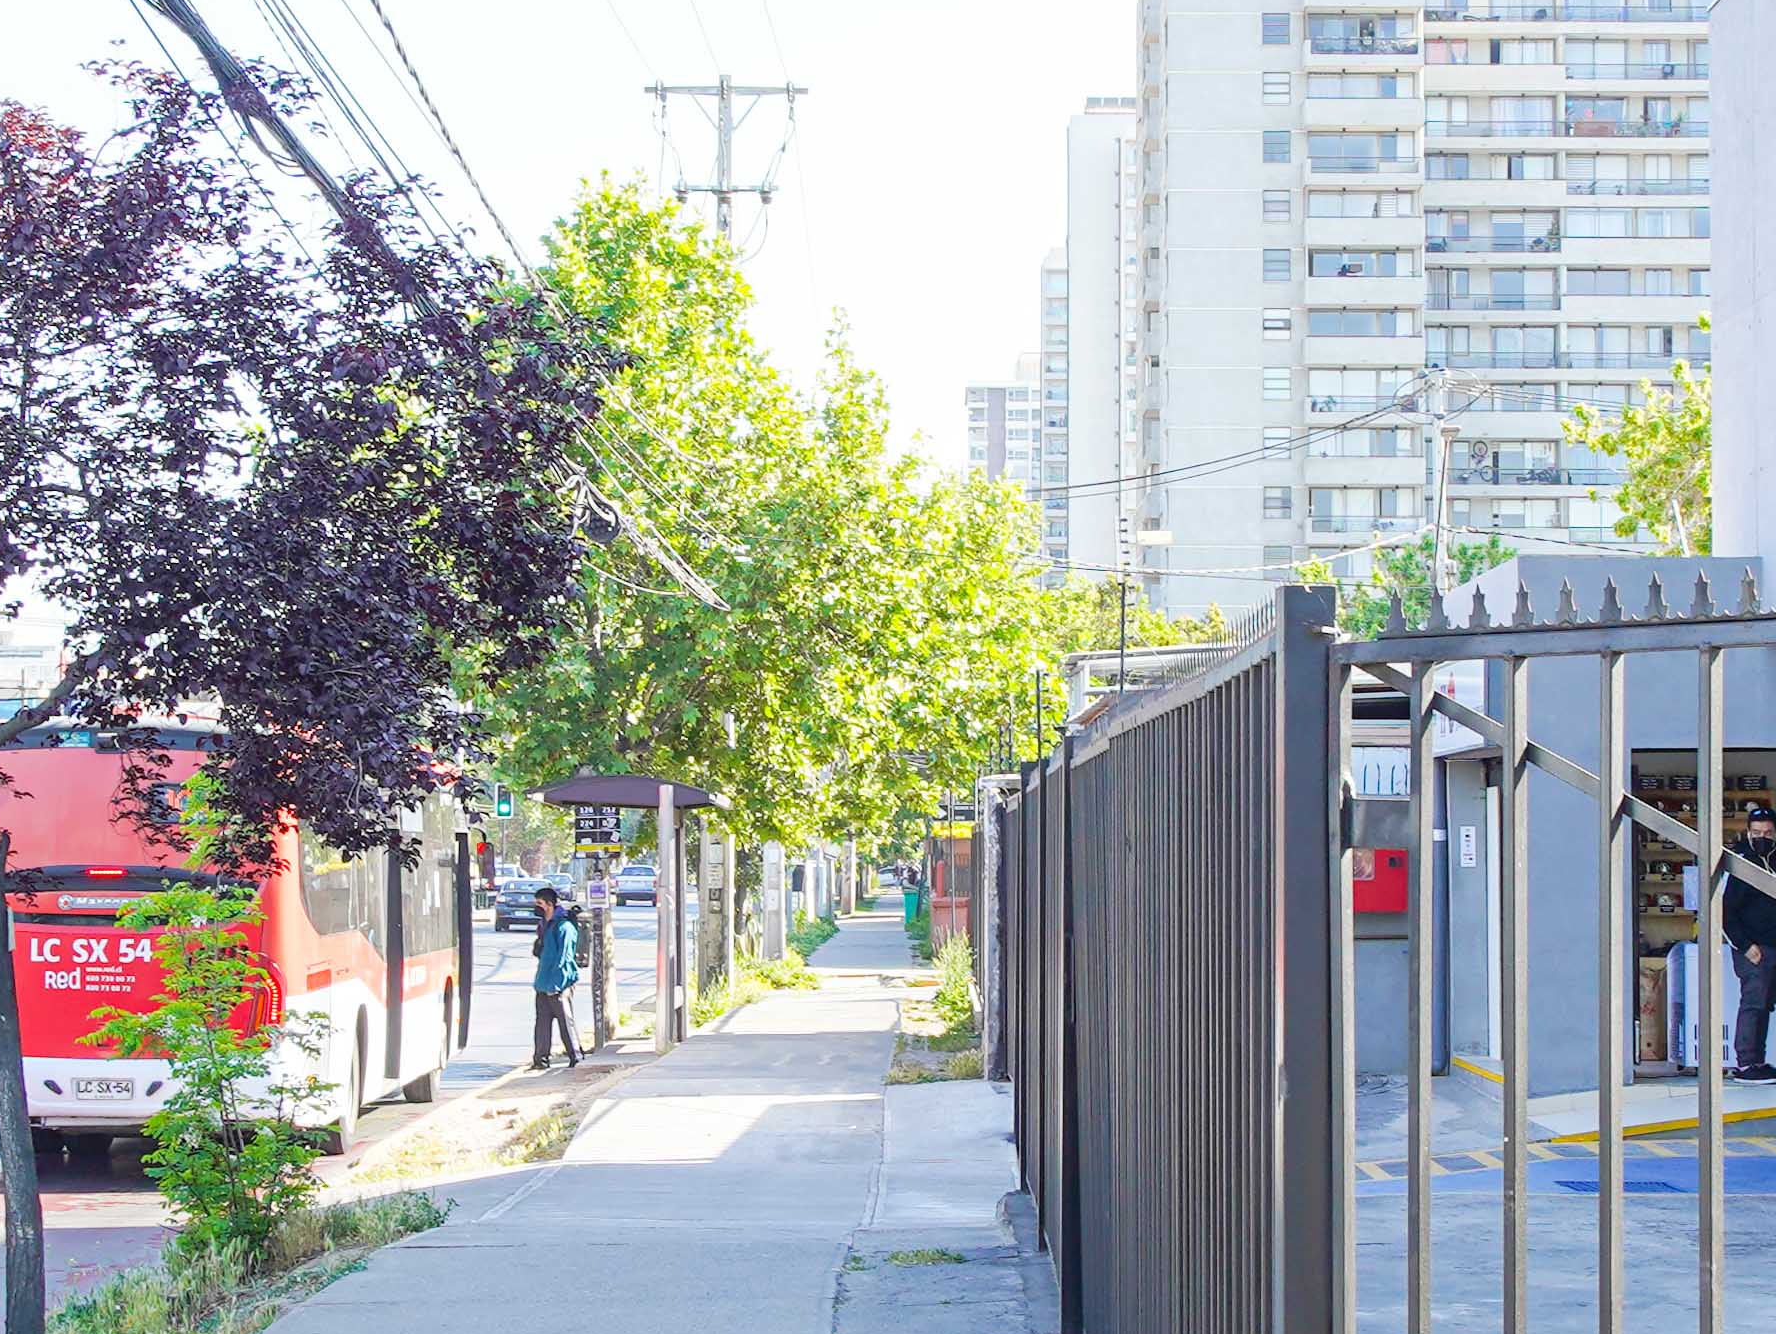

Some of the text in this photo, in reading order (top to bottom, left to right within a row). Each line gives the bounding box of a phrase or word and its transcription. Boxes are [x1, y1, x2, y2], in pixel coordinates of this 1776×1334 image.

[30, 938, 153, 964] LC SX 54
[44, 967, 82, 990] Red
